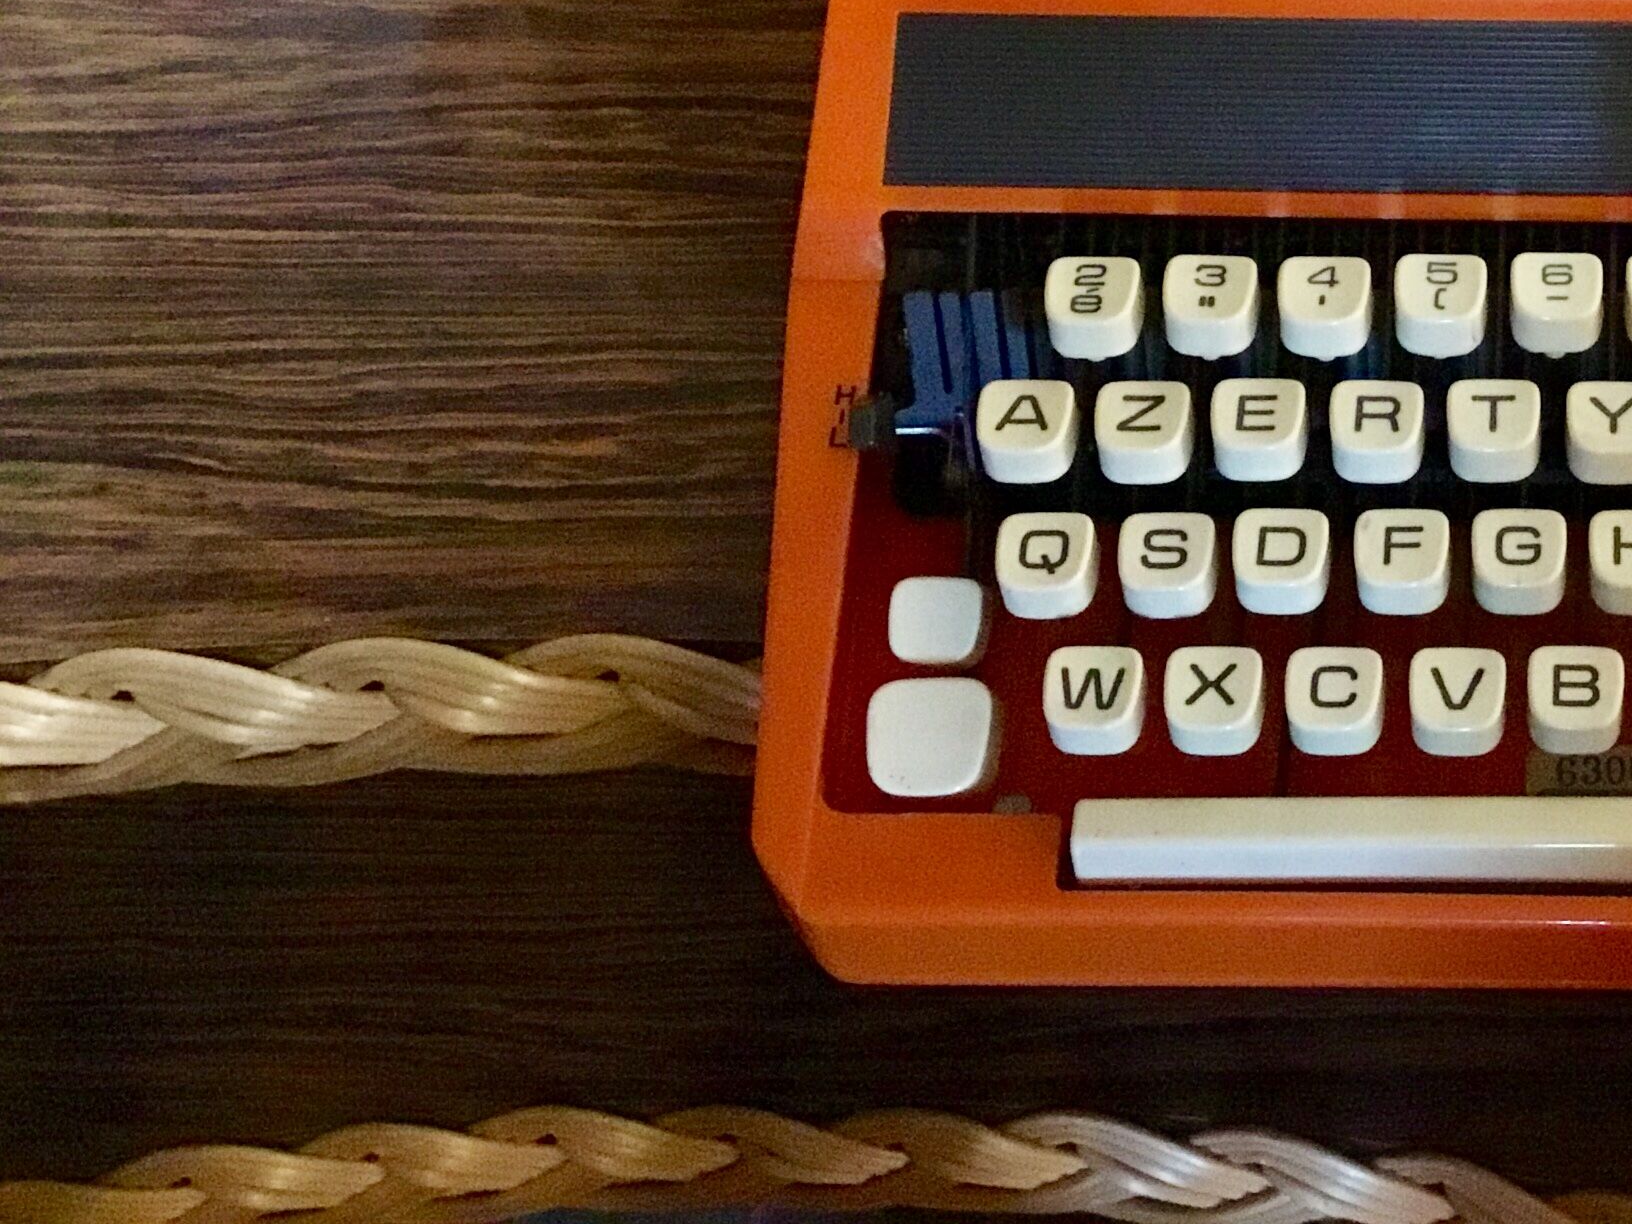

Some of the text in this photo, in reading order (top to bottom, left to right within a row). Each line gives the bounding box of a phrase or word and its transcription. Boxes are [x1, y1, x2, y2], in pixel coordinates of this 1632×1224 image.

[1074, 263, 1108, 287] 2
[1195, 264, 1227, 287] 3
[1307, 265, 1340, 288] 4
[1426, 261, 1458, 285] 5
[1541, 263, 1574, 286] 6
[996, 395, 1049, 432] A
[1116, 394, 1166, 432] Z
[1235, 394, 1279, 432] E
[1354, 395, 1401, 433] R
[1471, 394, 1516, 433] T
[1018, 529, 1070, 575] Q
[1140, 528, 1189, 570] S
[1256, 526, 1307, 567] D
[1383, 525, 1424, 566] F
[1495, 525, 1542, 566] G
[1061, 667, 1126, 711] W
[1185, 663, 1238, 706] X
[1310, 665, 1359, 709] C
[1430, 667, 1485, 711] V
[1552, 663, 1601, 708] B
